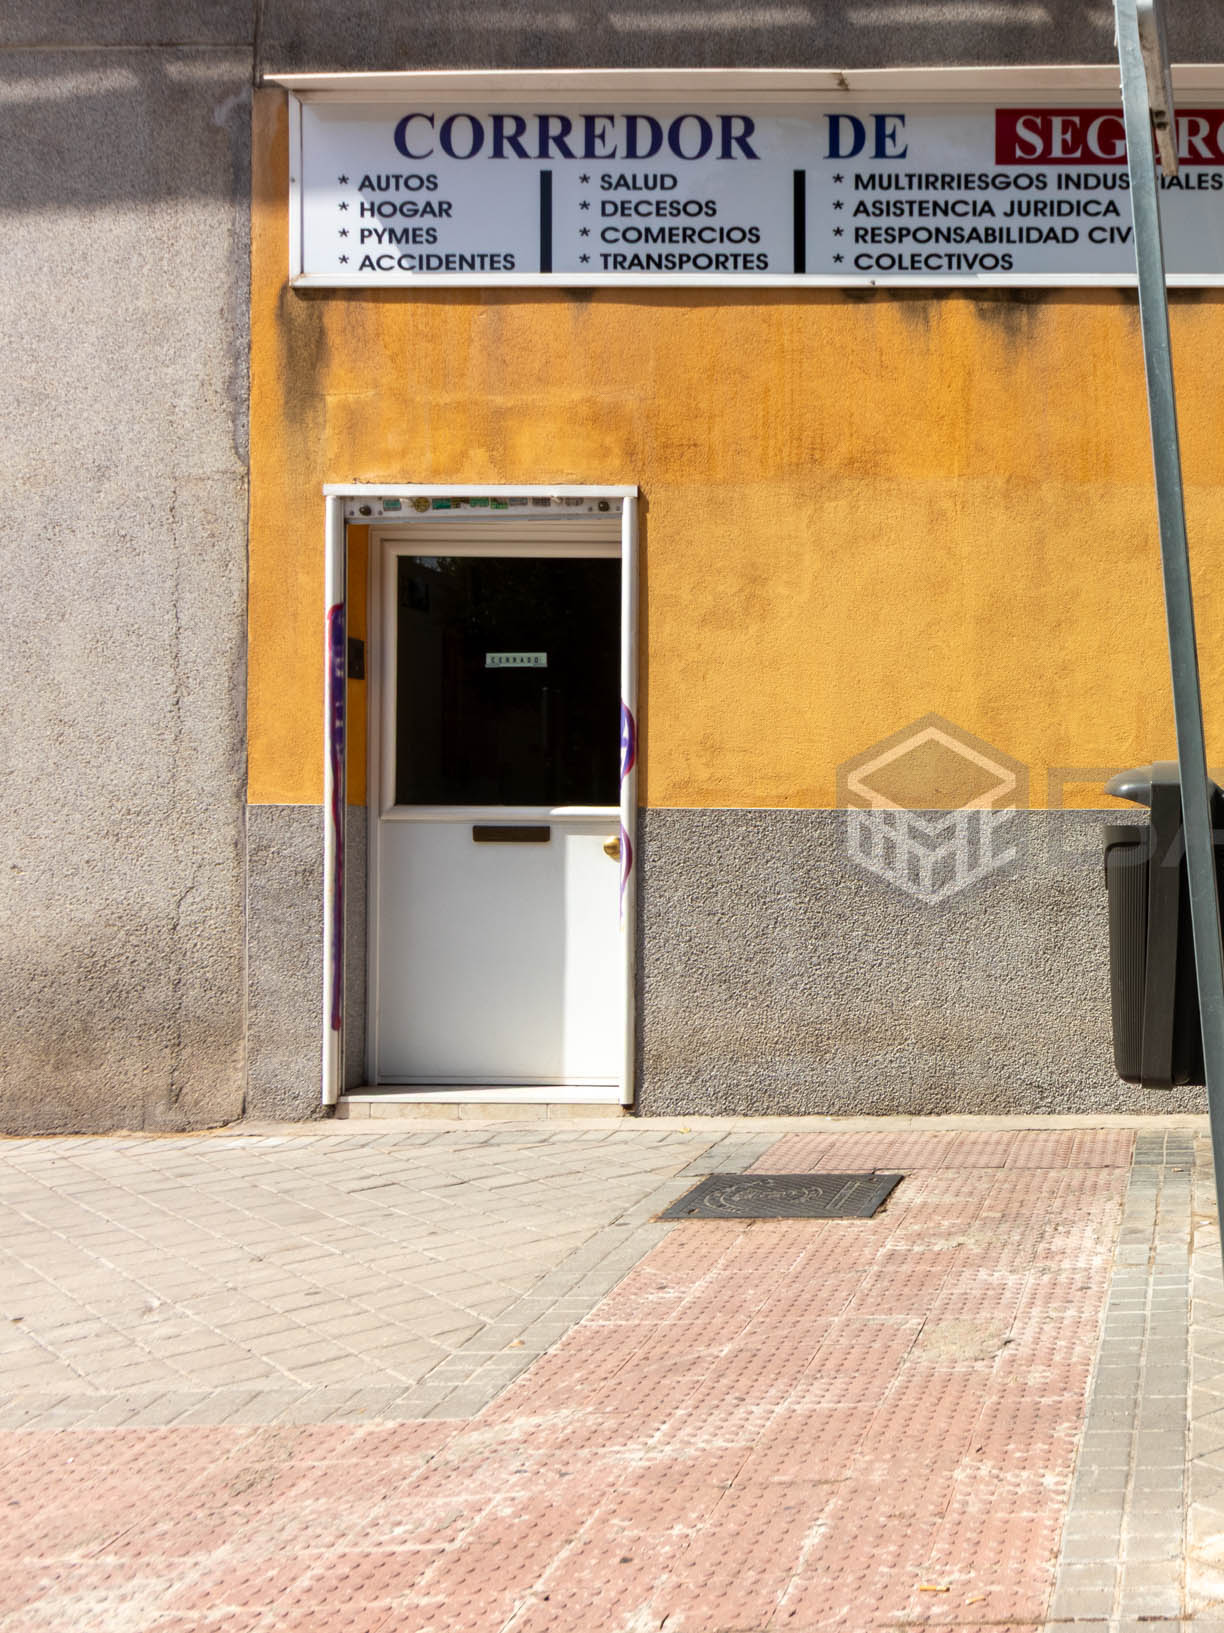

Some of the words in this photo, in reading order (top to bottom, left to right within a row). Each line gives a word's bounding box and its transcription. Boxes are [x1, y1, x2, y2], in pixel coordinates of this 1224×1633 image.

[393, 112, 761, 160] CORREDOR
[823, 113, 908, 160] DE
[358, 173, 439, 192] AUTOS
[600, 172, 678, 192] SALUD
[853, 172, 1048, 191] MULTIRRIESGOS
[1056, 172, 1224, 191] INDUSIALES
[359, 200, 453, 219] HOGAR
[600, 199, 718, 218] DECESOS
[852, 199, 996, 218] ASISTENCIA
[1003, 199, 1121, 218] JURIDICA
[359, 227, 438, 245] PYMES
[599, 226, 761, 245] COMERCIOS
[854, 226, 1080, 245] RESPONSABILIDAD
[1088, 226, 1134, 245] CIV
[358, 253, 516, 272] ACCIDENTES
[600, 252, 770, 272] TRANSPORTES
[853, 252, 1014, 271] COLECTIVOS
[490, 656, 539, 664] CERRADO
